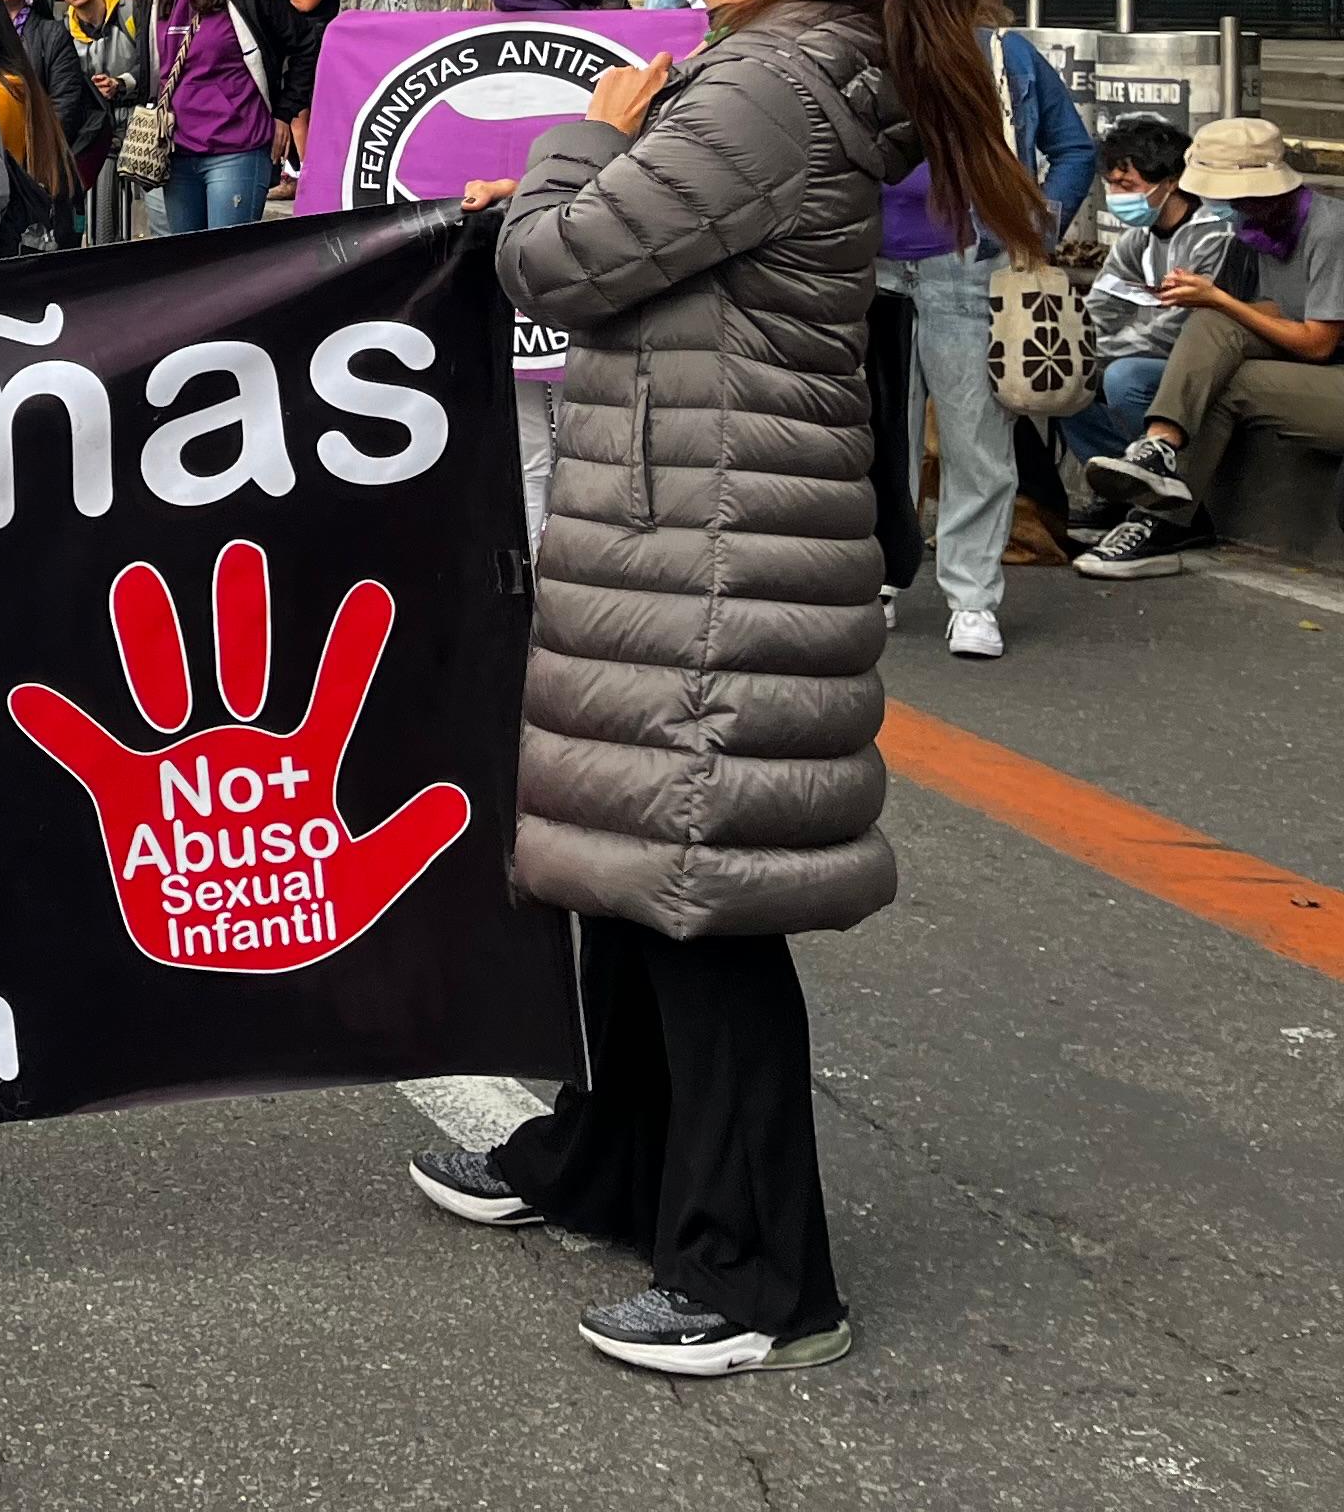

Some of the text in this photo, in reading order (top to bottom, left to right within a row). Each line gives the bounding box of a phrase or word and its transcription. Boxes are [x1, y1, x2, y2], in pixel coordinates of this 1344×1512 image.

[360, 48, 479, 189] FEMINISTAS
[123, 817, 339, 881] Abuso
[161, 859, 325, 915] Sexual
[167, 900, 337, 958] Infantil
